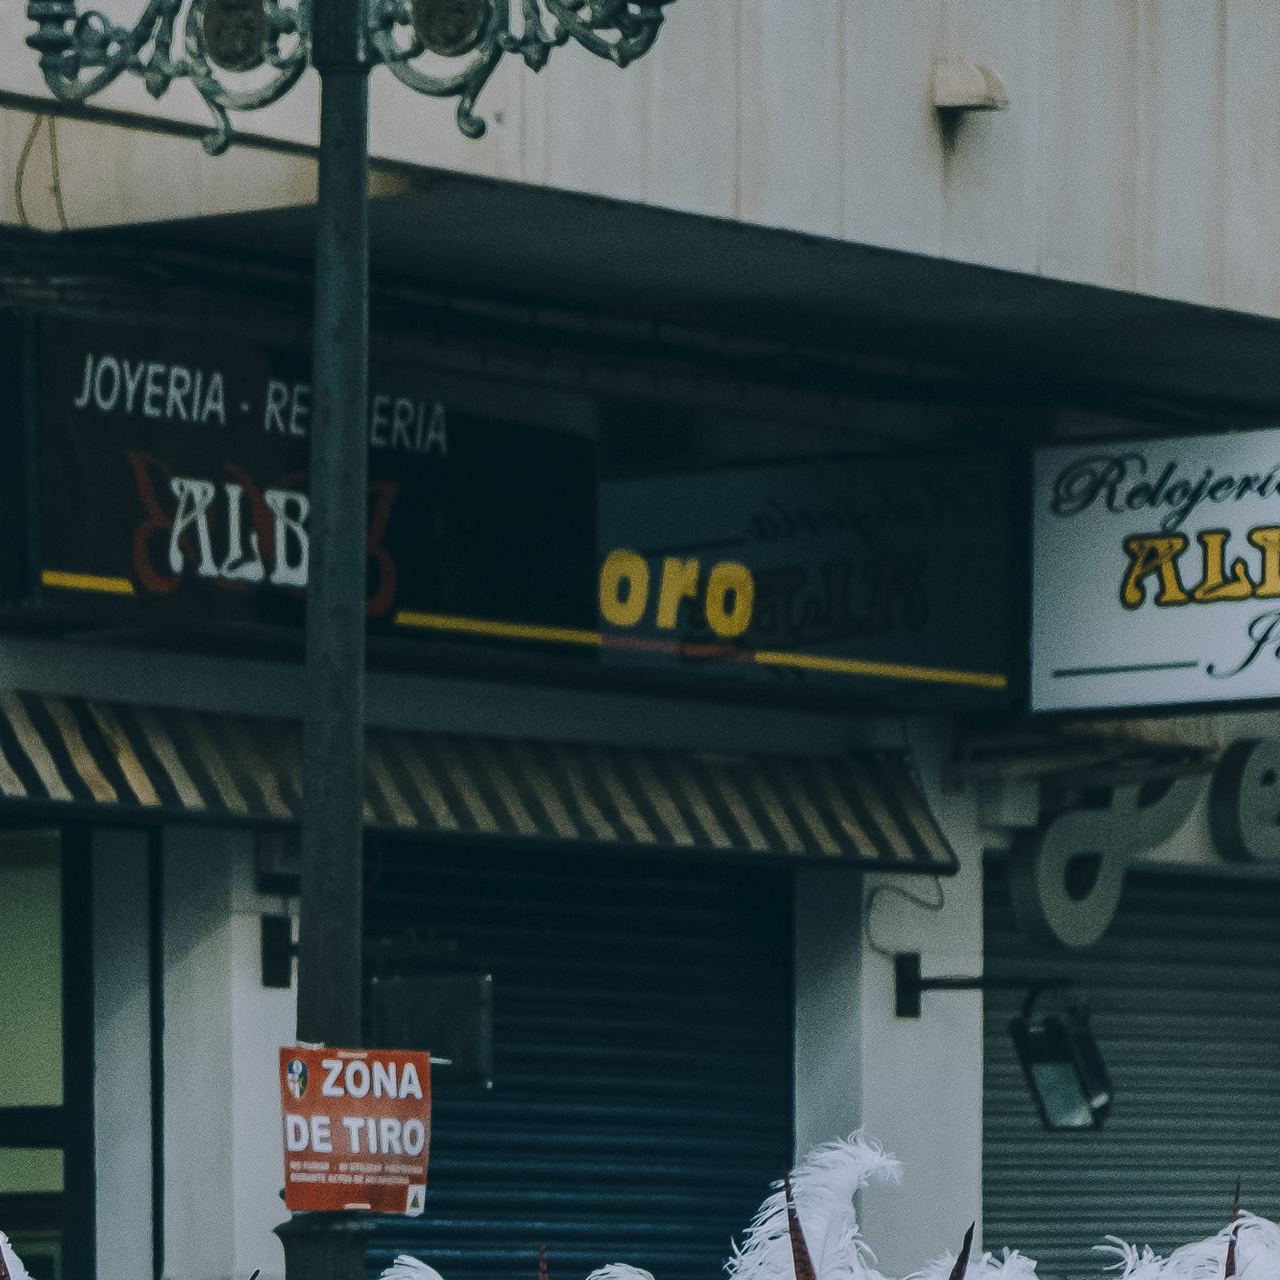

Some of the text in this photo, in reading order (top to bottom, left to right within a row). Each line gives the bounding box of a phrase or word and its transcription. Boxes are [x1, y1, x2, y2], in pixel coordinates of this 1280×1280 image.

[74, 353, 448, 455] JOYERIA REERIA
[599, 549, 756, 639] oro
[321, 1058, 423, 1101] ZONA
[285, 1113, 426, 1157] DE TIRO
